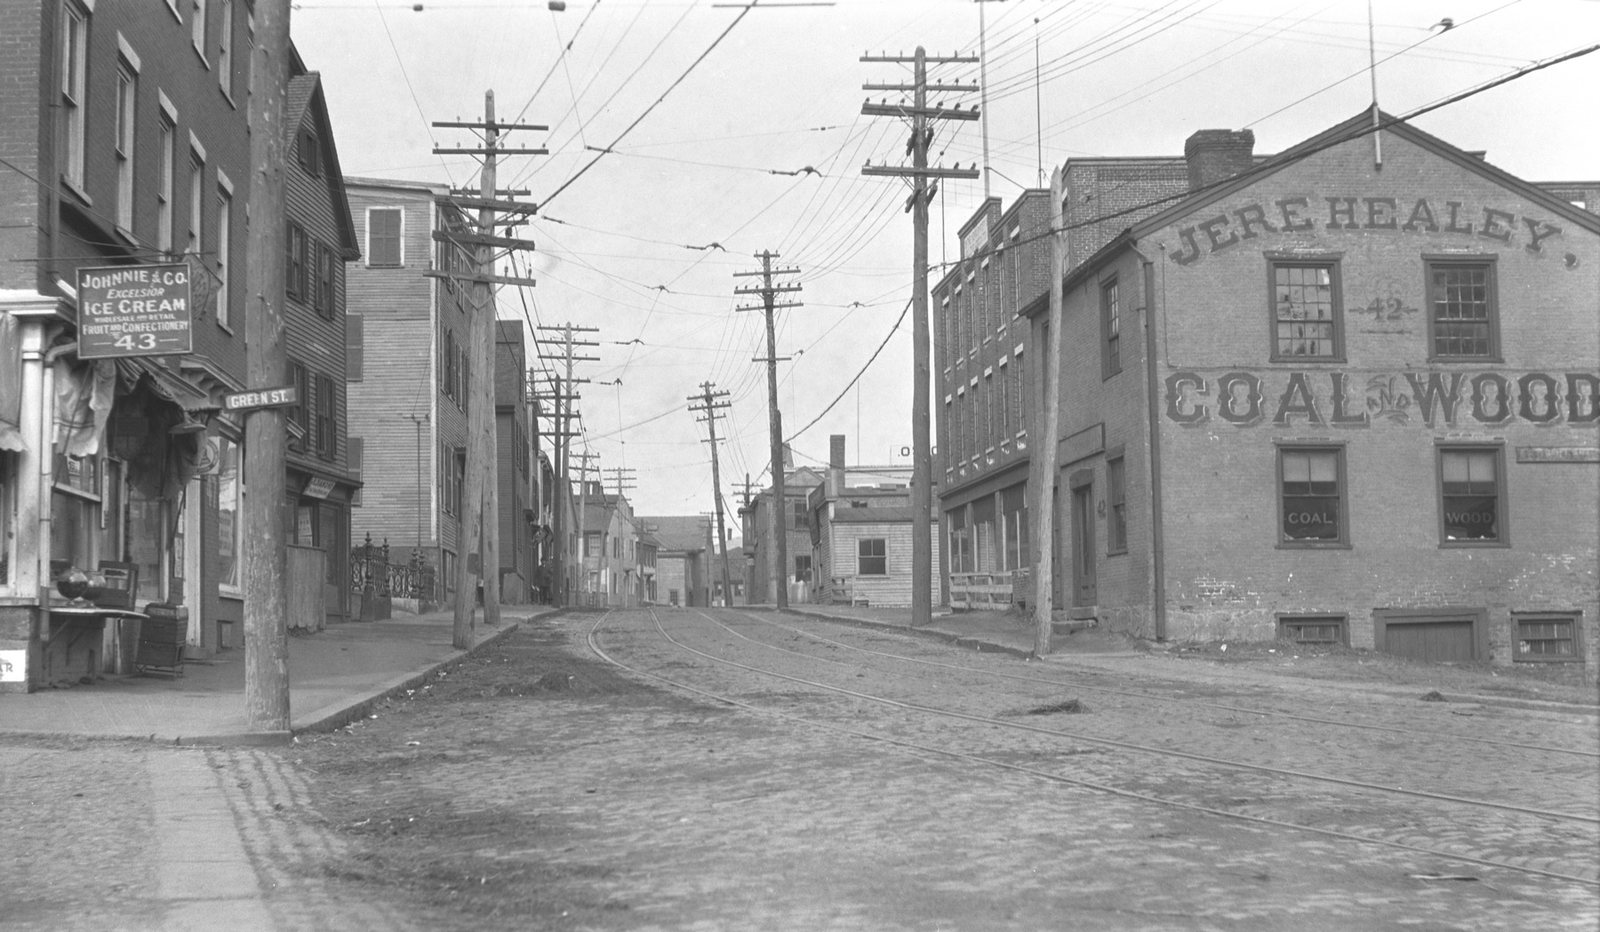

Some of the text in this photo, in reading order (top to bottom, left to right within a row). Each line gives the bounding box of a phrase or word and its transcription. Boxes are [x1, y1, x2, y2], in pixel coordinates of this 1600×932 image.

[1169, 197, 1314, 266] JERE
[81, 270, 149, 289] JOHNNIE
[151, 270, 161, 284] &
[106, 287, 165, 299] EXCELSIOR
[84, 298, 186, 316] ICE CREAM
[1364, 297, 1402, 321] 42
[82, 320, 188, 335] FRUIT AND CONFECTIONERY
[94, 315, 135, 323] WHOLESALE
[113, 333, 156, 350] 43
[231, 389, 288, 408] GREEN ST.
[1165, 372, 1371, 429] COAL
[1403, 372, 1600, 428] WOOD
[1287, 512, 1333, 524] COAL
[1446, 512, 1492, 524] WOOD
